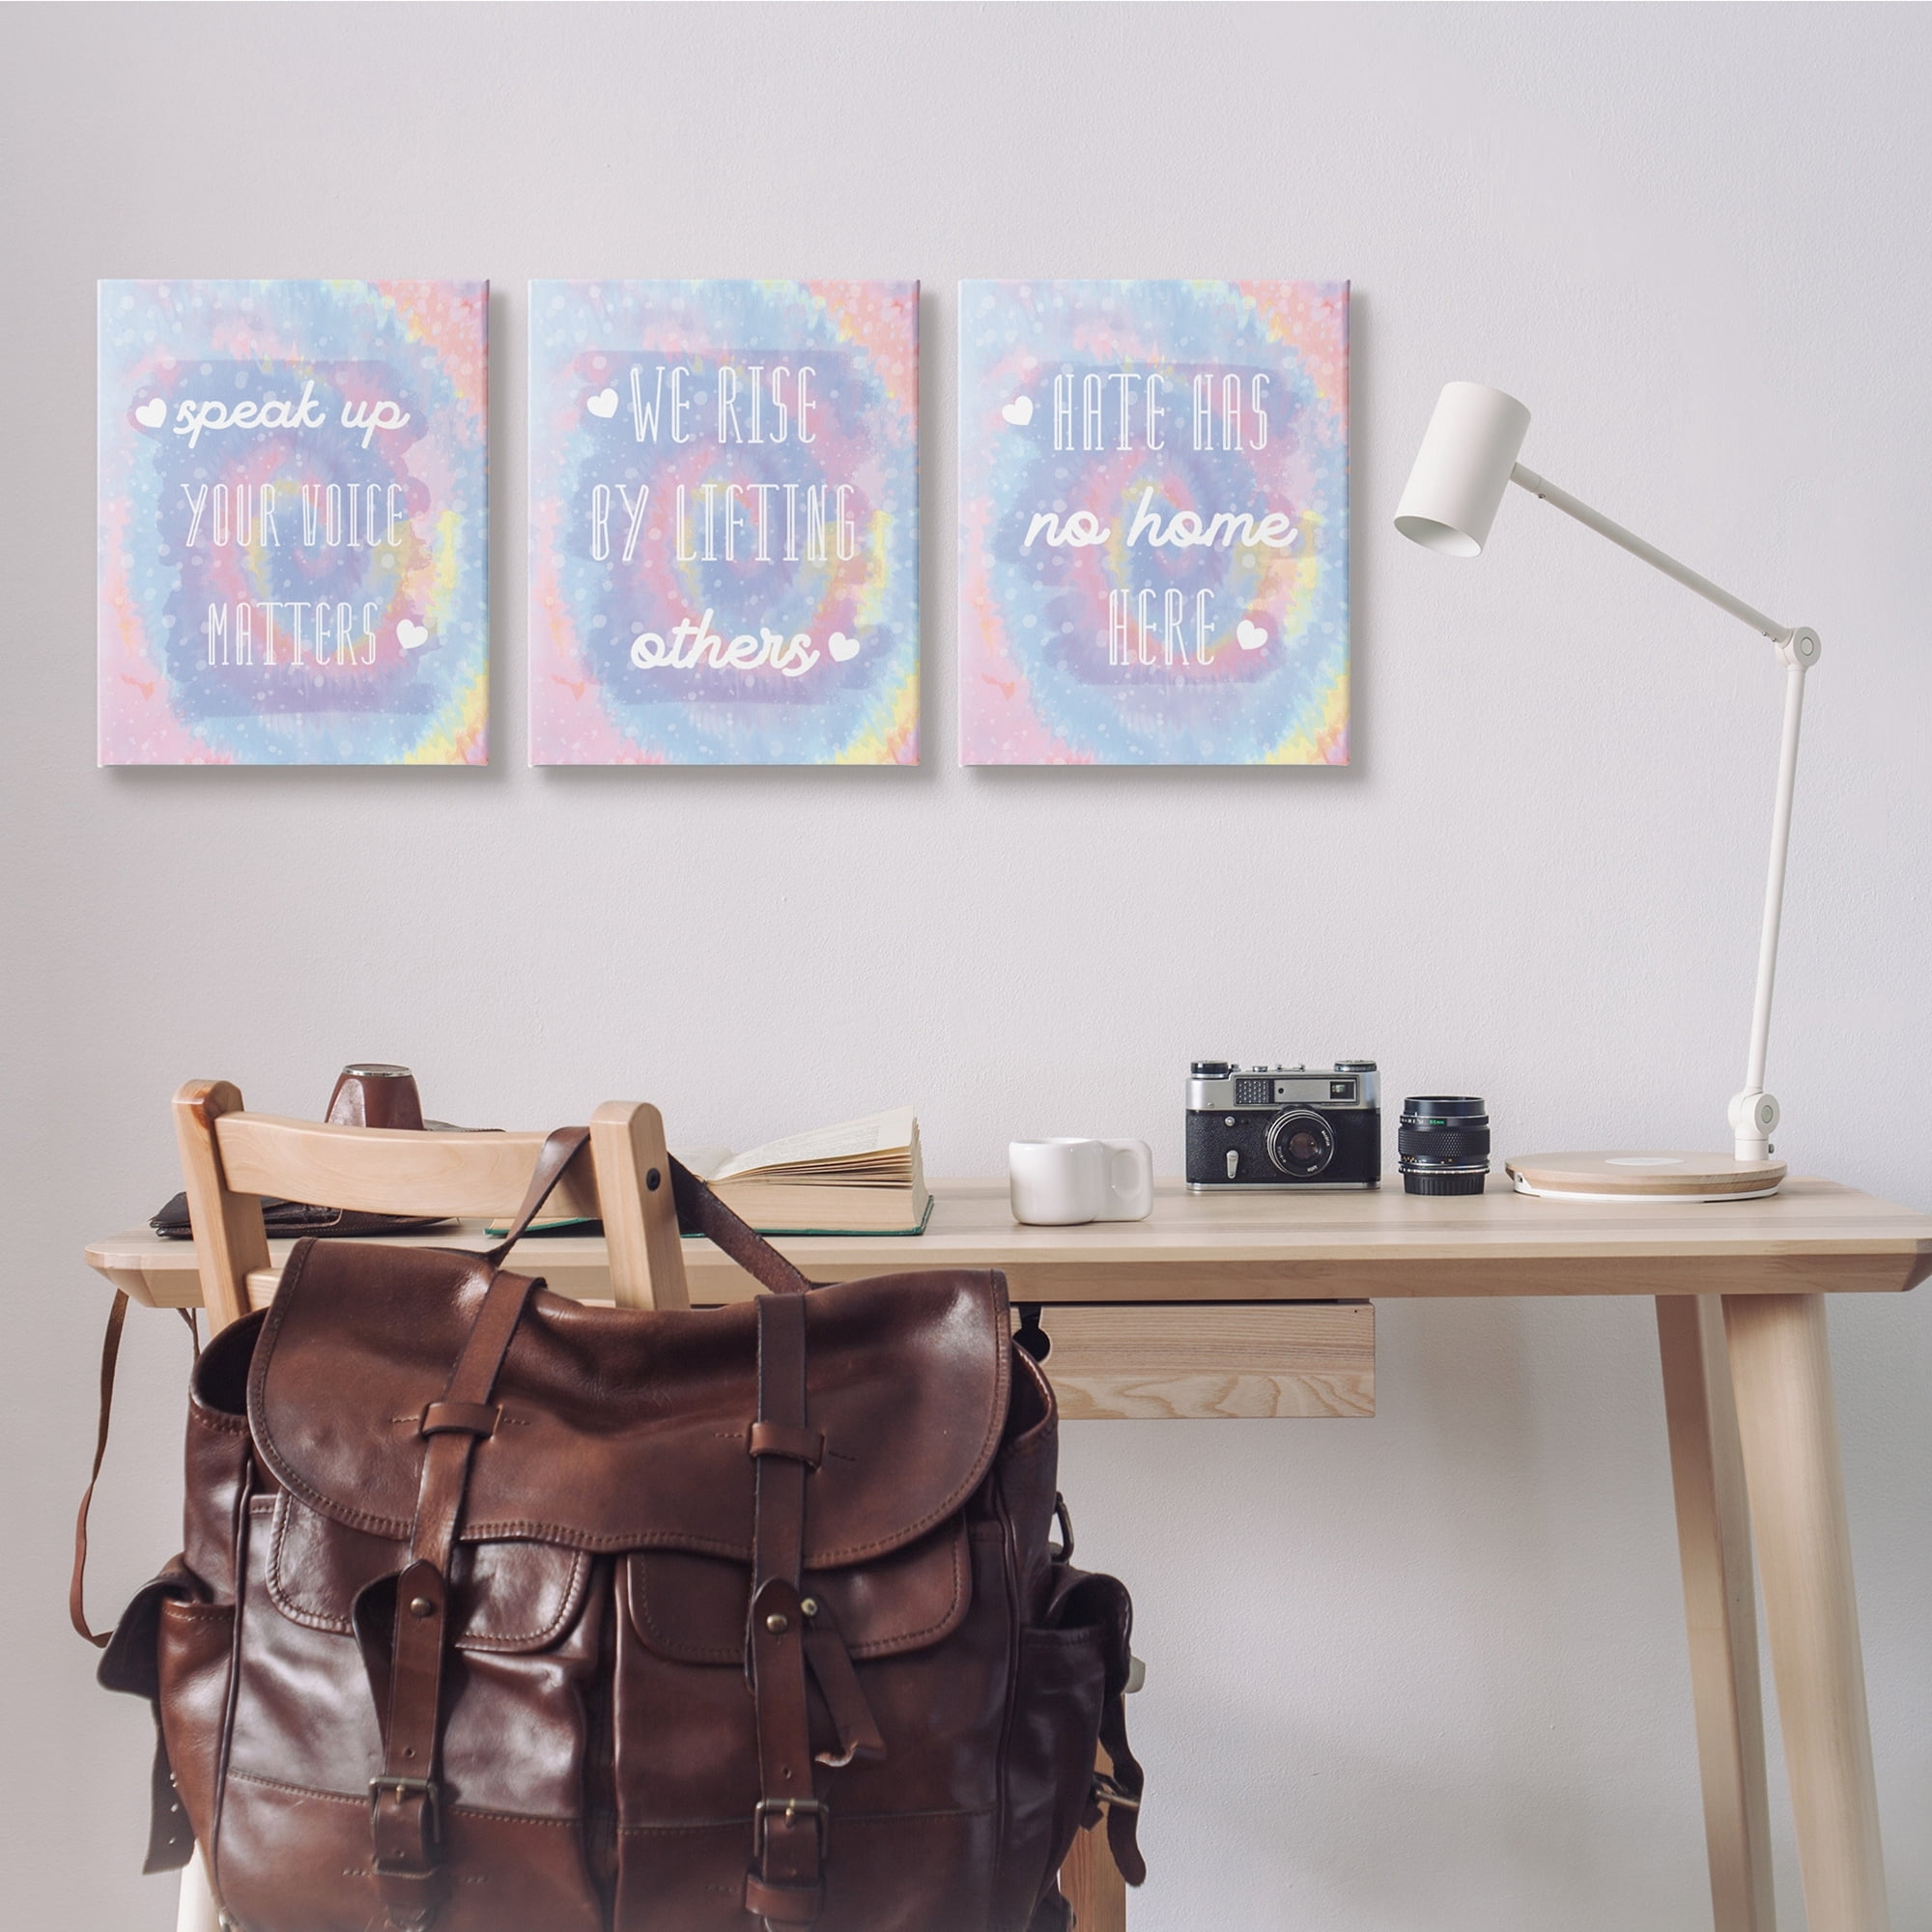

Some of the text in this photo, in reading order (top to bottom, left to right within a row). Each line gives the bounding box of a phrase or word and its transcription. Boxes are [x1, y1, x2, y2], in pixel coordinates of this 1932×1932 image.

[173, 379, 411, 449] speak up
[630, 366, 816, 443] WE RISE
[1054, 373, 1270, 451] HATE HAS
[181, 483, 404, 548] YOUR VOICE
[591, 484, 855, 562] BY LIFTING
[1024, 485, 1298, 548] no home
[207, 602, 379, 666] MATTERS
[630, 608, 819, 677] others
[1109, 588, 1215, 667] HERE
